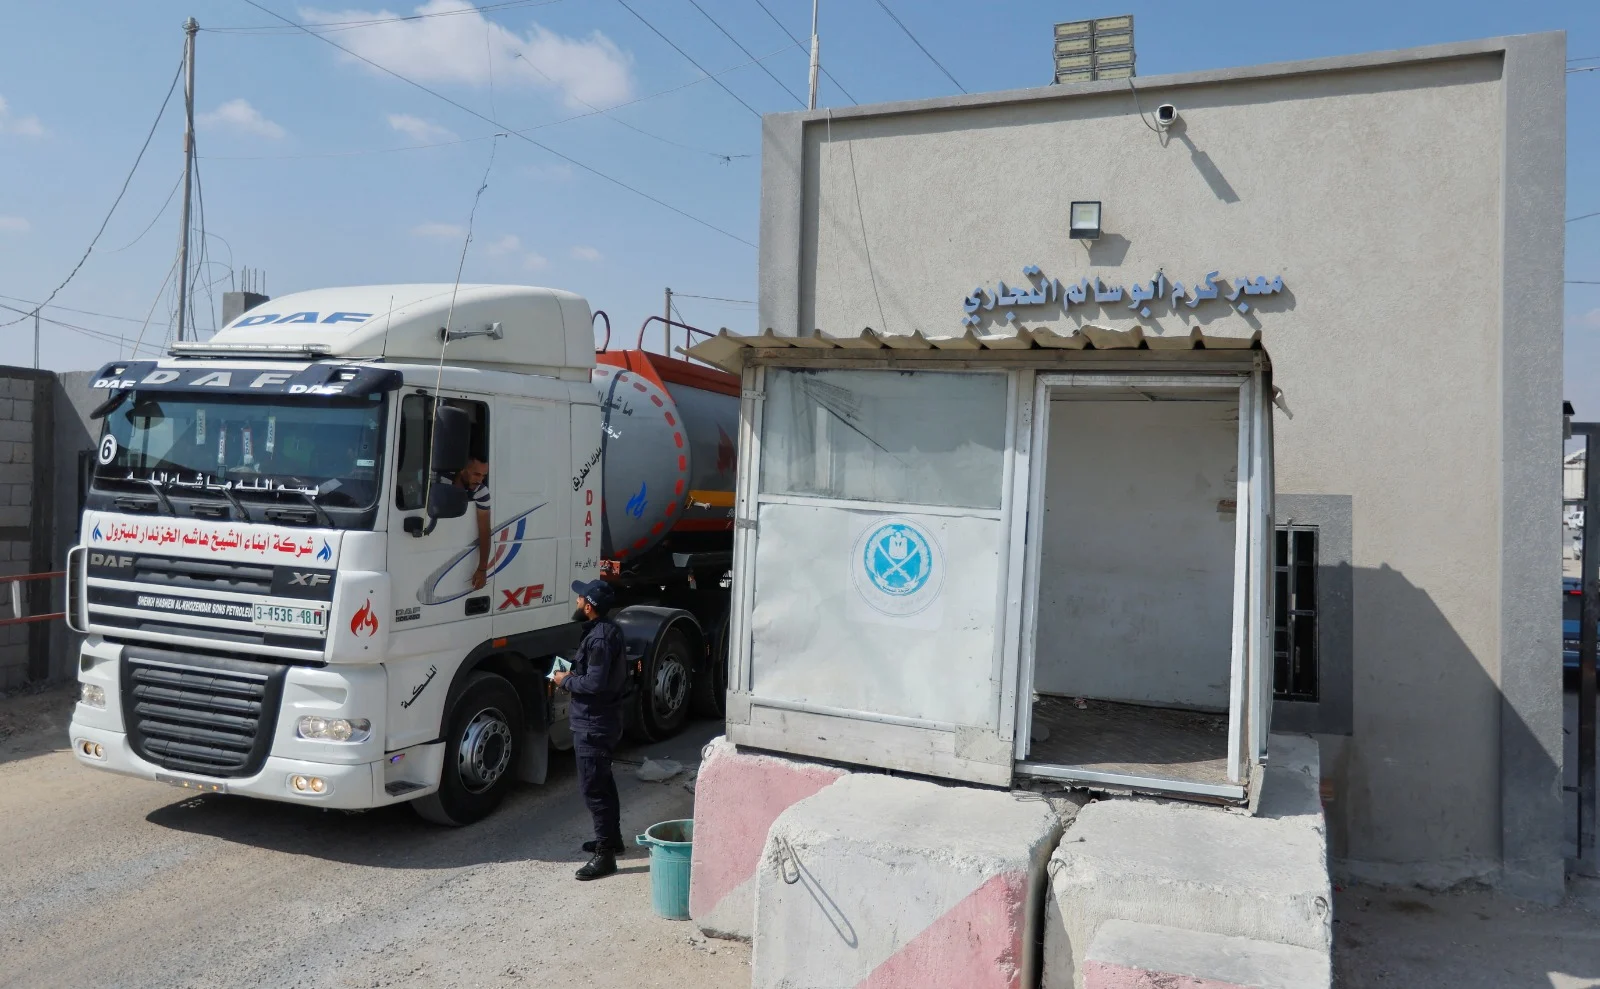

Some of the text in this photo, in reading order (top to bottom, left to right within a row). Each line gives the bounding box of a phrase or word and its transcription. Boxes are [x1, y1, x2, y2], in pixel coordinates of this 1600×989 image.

[961, 264, 1059, 327] التجاري
[1063, 276, 1123, 312] سالم
[1172, 270, 1221, 310] كرم
[1225, 274, 1283, 315] معبر
[231, 311, 375, 329] DAF
[93, 379, 137, 389] DAF
[141, 370, 293, 388] DAF
[288, 384, 346, 395] DAF
[101, 439, 113, 460] 6
[126, 471, 320, 500] بسم الله ما شاء الله
[584, 489, 594, 548] DAF
[106, 522, 314, 558] شركة أبناء الشيخ هاشم الخزندار للبترول
[91, 553, 133, 568] DAF
[287, 572, 332, 587] XF
[496, 583, 553, 611] XF 105
[211, 604, 226, 615] SONS
[395, 606, 421, 617] DAF
